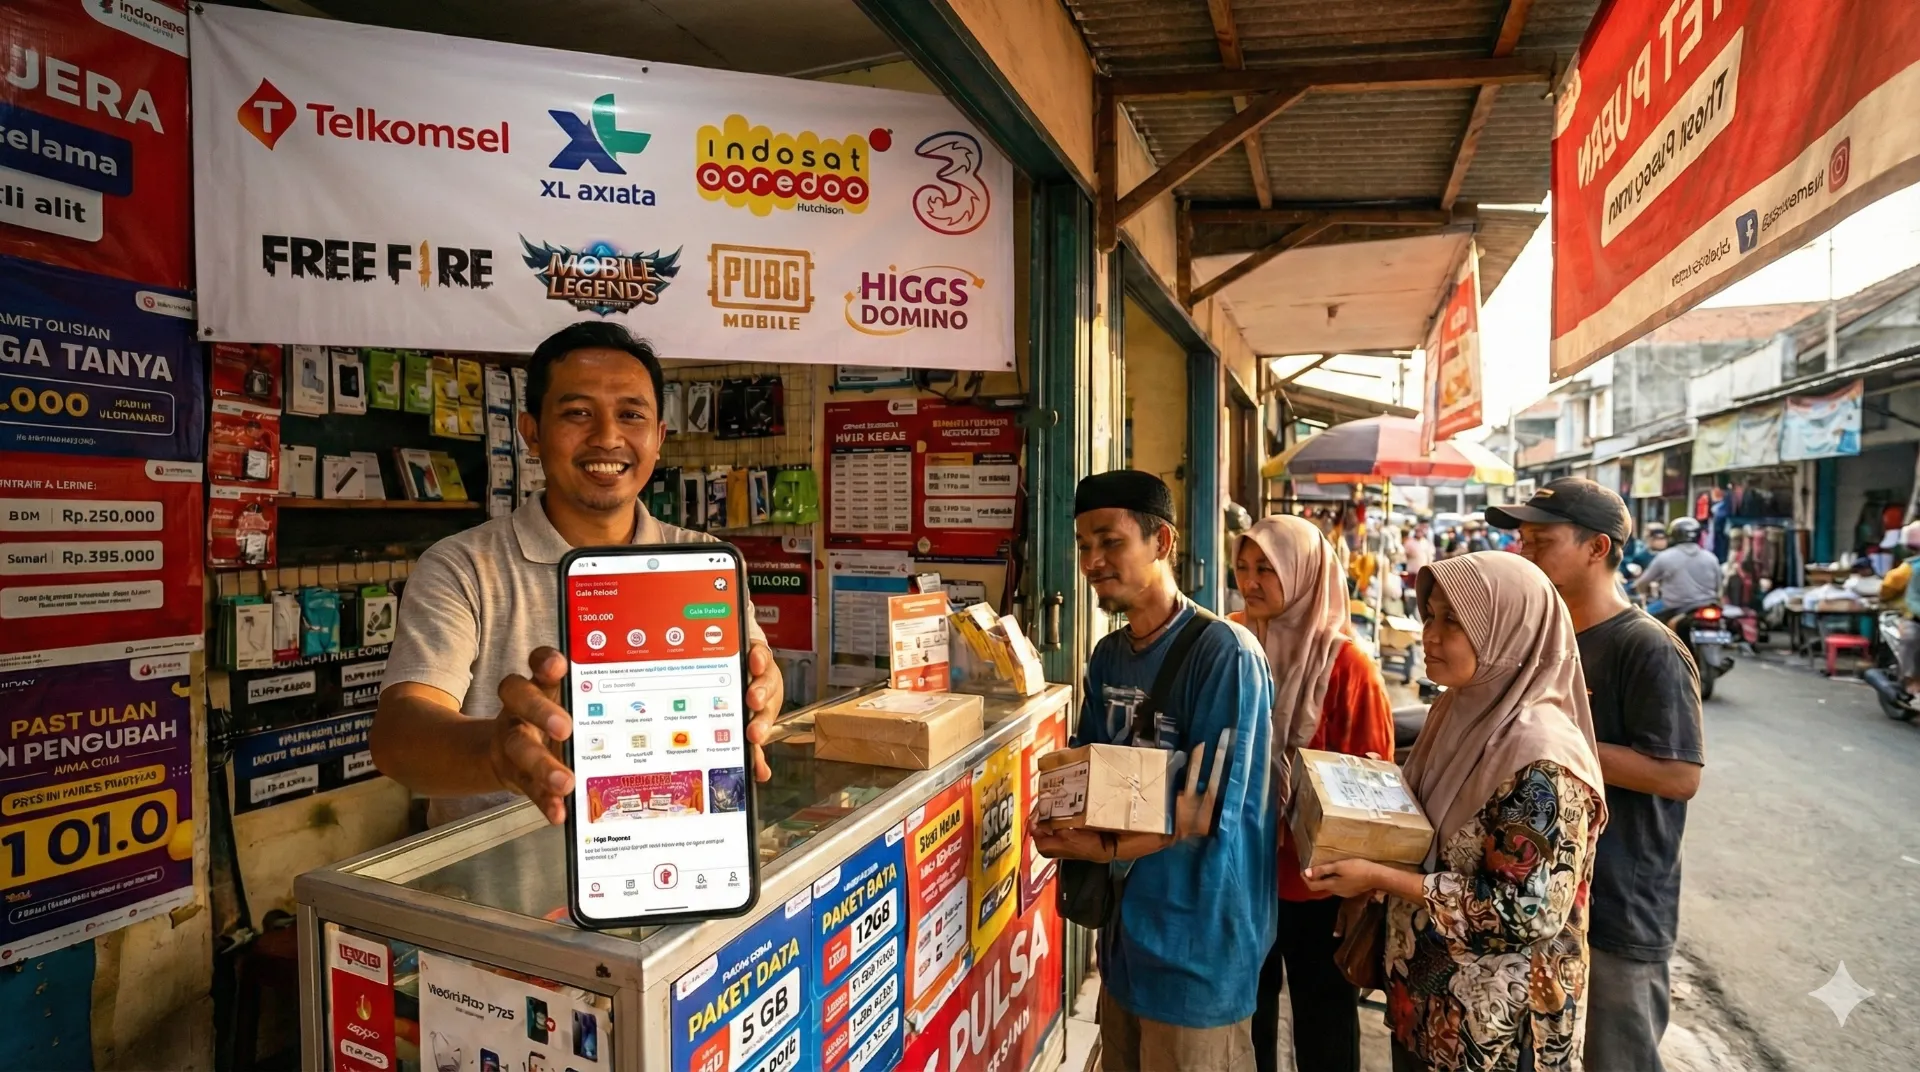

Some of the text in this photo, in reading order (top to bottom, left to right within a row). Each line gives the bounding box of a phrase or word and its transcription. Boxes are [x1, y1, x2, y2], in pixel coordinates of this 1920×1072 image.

[306, 102, 510, 154] Telkomsel
[708, 137, 861, 173] indosat
[540, 179, 656, 207] XL axiata
[700, 166, 865, 202] ooredoo
[0, 185, 86, 223] li alit
[797, 202, 845, 215] Hutchison
[261, 234, 494, 291] FREE FIRE
[547, 252, 657, 281] MOBILE
[723, 255, 800, 301] PUBG
[550, 275, 659, 304] LEGENDS
[722, 313, 800, 331] MOBILE
[861, 306, 968, 330] DOMINO
[60, 342, 173, 382] TANYA
[62, 550, 155, 566] Rp.395.000
[11, 700, 157, 740] PAST ULAN
[24, 719, 177, 765] PENGUBAH
[821, 884, 865, 935] PAKET
[688, 971, 753, 1043] PAKET
[756, 937, 801, 989] DATA
[949, 909, 1050, 1072] PULSA
[741, 986, 789, 1045] 5 GB
